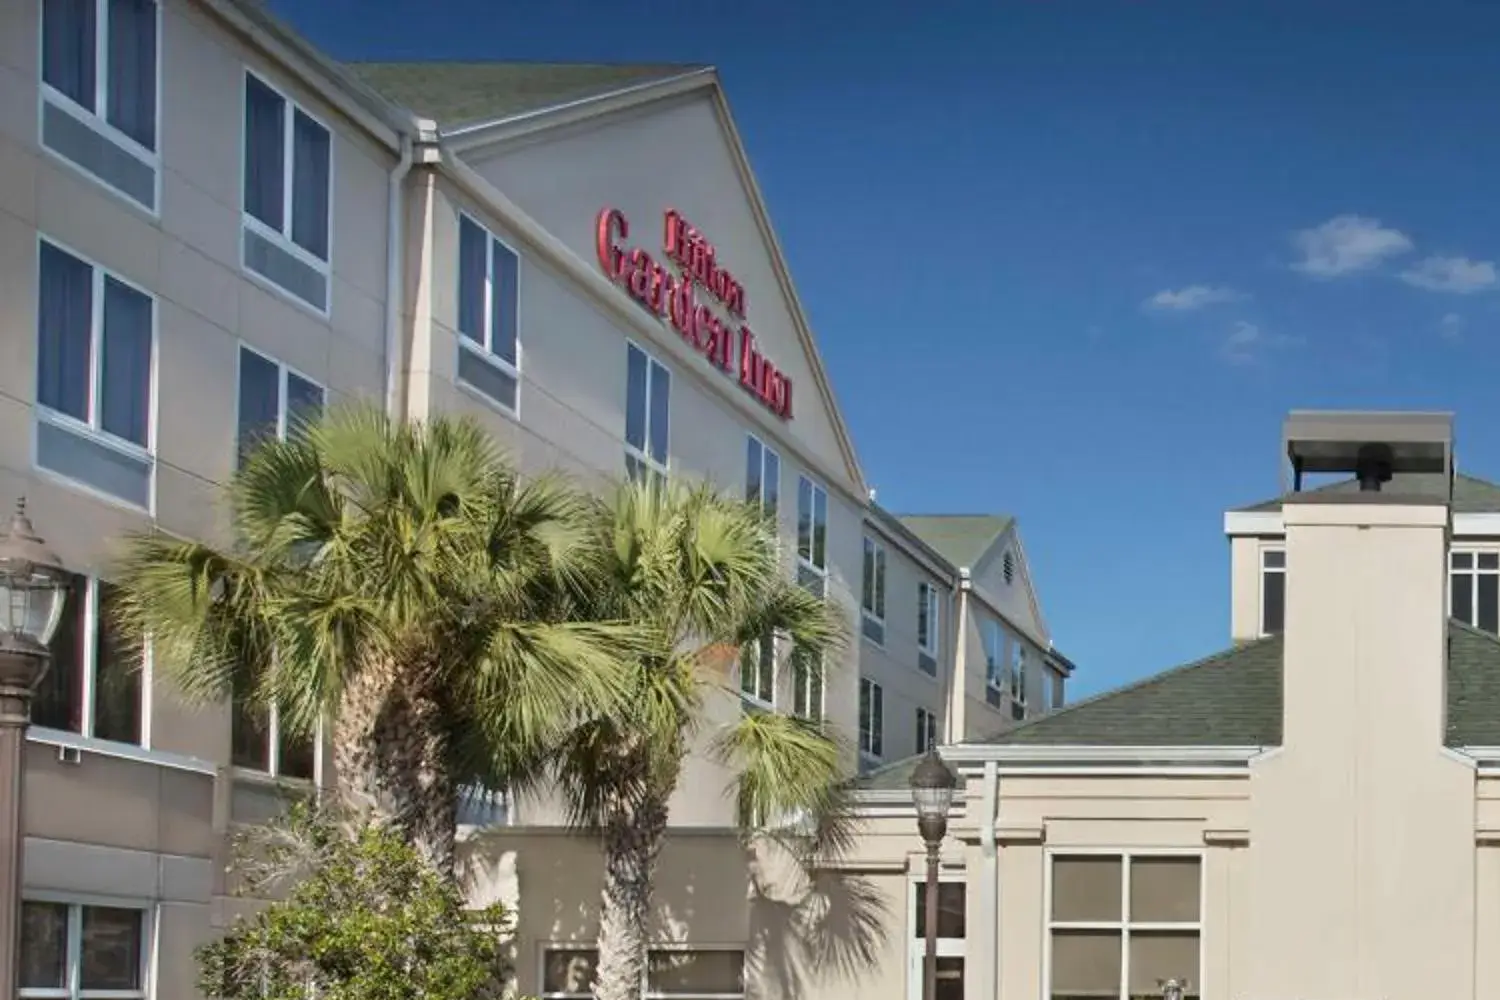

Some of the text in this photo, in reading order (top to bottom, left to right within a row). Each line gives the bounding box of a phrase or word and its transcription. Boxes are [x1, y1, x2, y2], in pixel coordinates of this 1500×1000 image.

[597, 207, 793, 420] Garden Inn
[664, 207, 746, 319] Hilton
